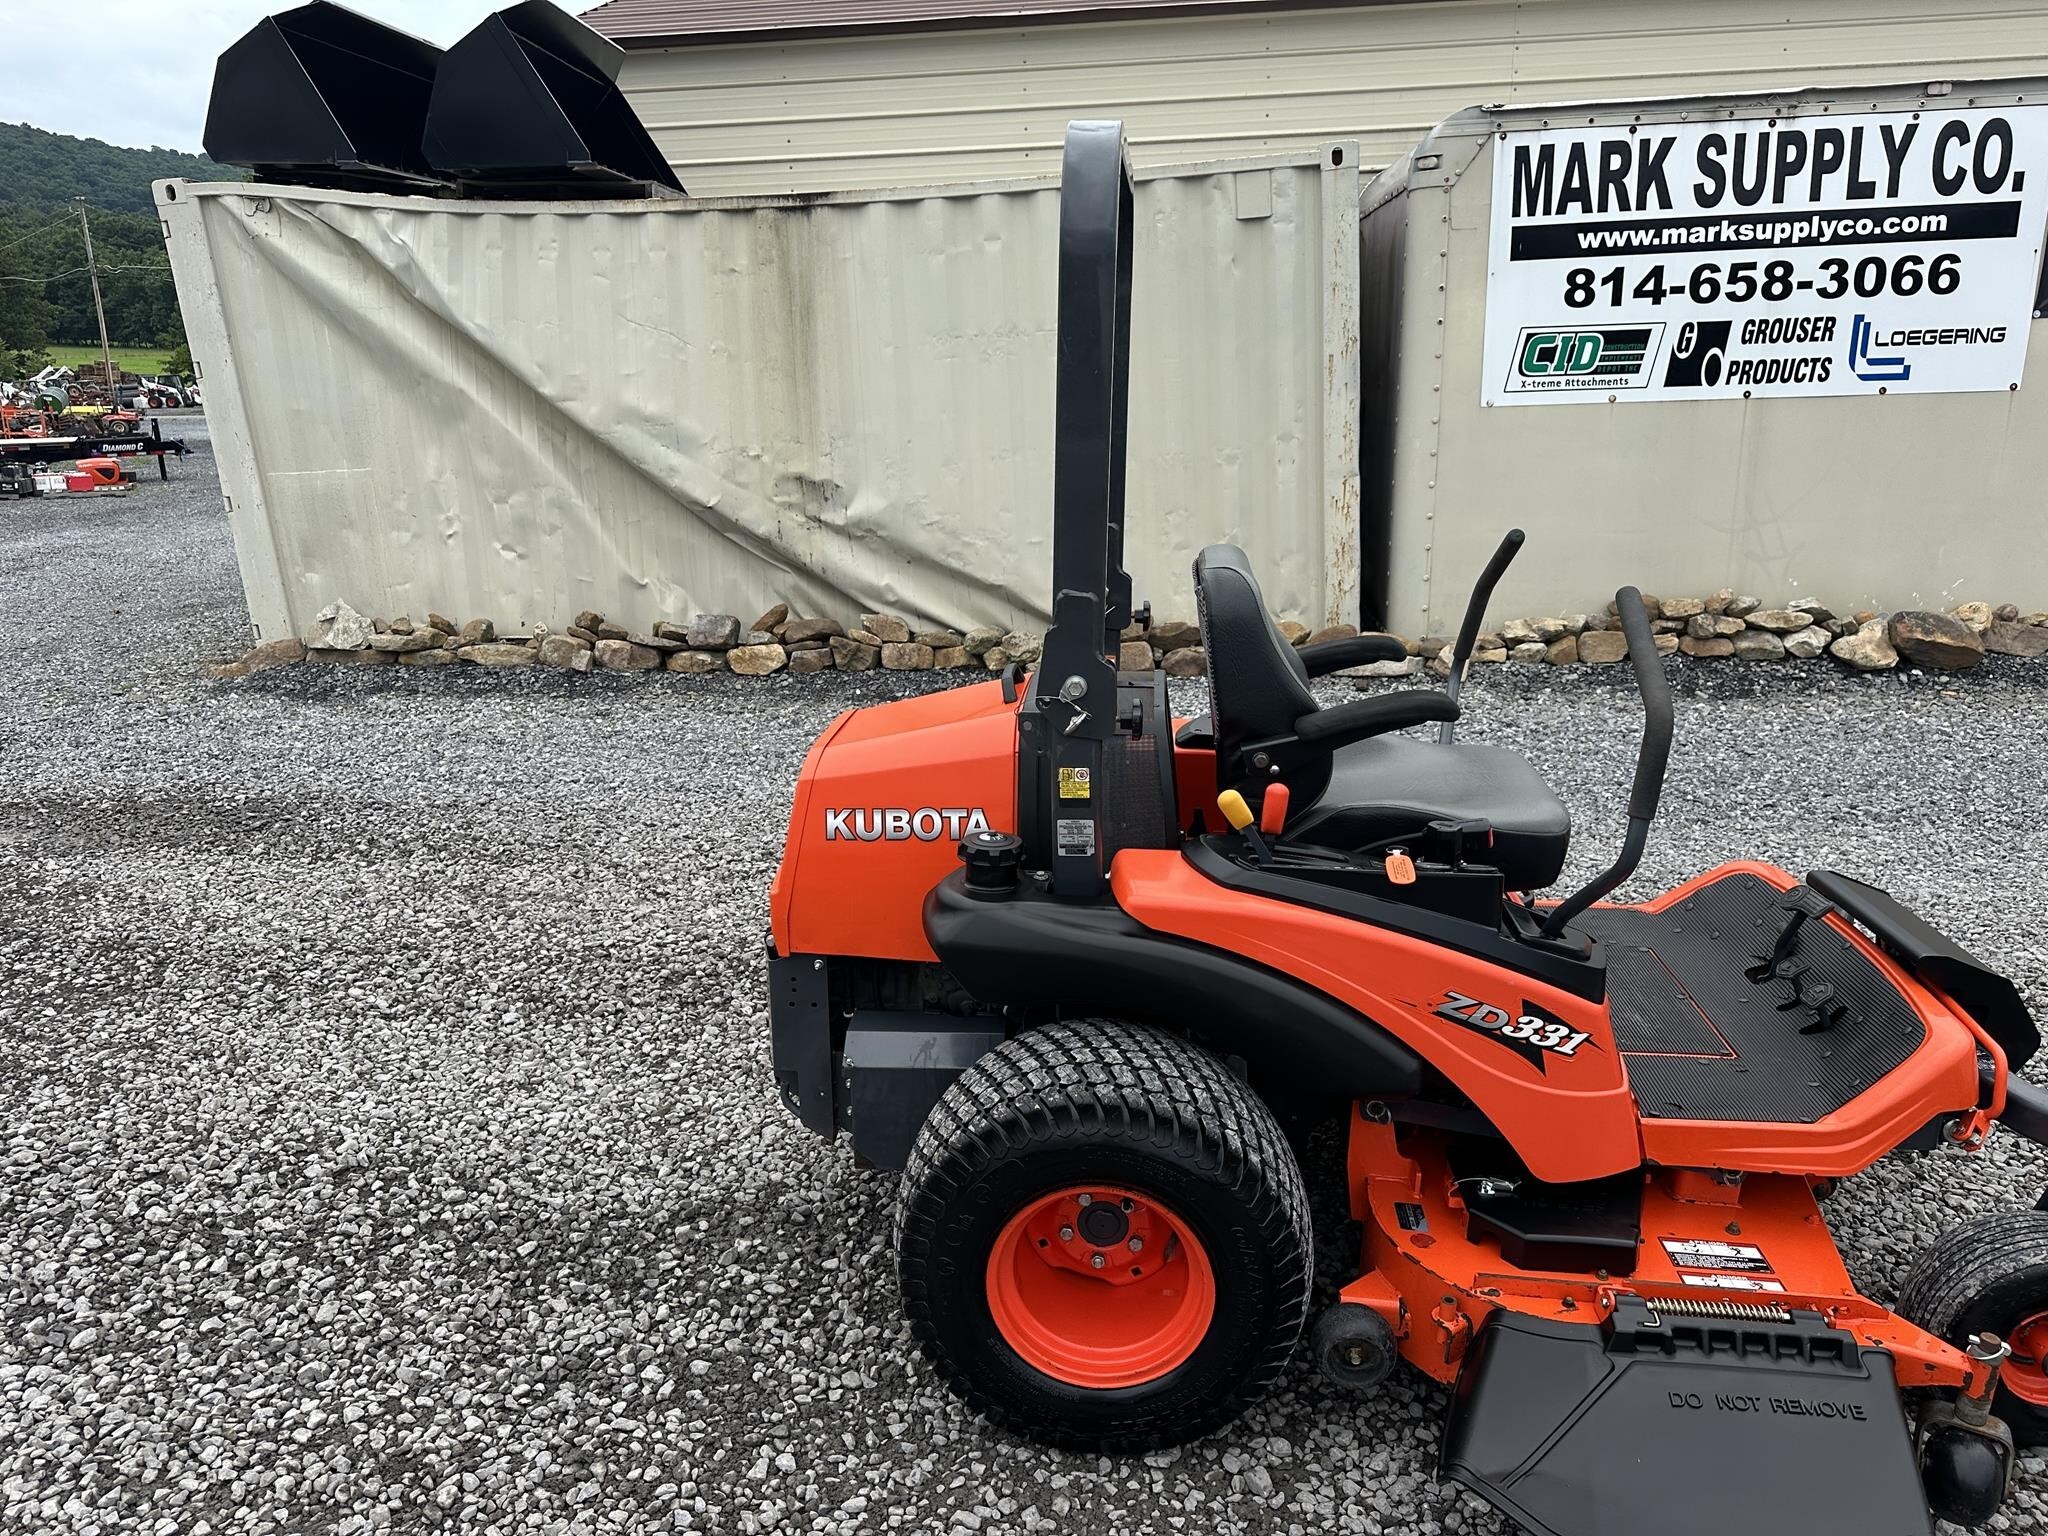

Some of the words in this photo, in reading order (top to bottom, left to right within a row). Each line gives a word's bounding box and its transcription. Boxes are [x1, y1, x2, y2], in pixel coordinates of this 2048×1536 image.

[1511, 136, 1677, 218] MARK
[1693, 123, 1919, 210] SUPPLY
[1932, 118, 2025, 196] CO.
[1577, 211, 1947, 250] www.marksupplyco.com
[1563, 253, 1961, 309] 814-658-3066
[1741, 316, 1837, 345] GROUSER
[1875, 326, 2007, 347] LOEGERING
[1523, 334, 1603, 375] CID
[1520, 379, 1562, 389] X-treme
[1565, 376, 1629, 387] Attachments
[1725, 357, 1832, 386] PRODUCTS
[102, 443, 136, 452] DIAMOND
[137, 442, 144, 450] C
[825, 807, 990, 841] KUBOTA
[1436, 991, 1590, 1055] ZD331
[1669, 1392, 1703, 1409] DO
[1715, 1394, 1760, 1412] NOT
[1769, 1397, 1867, 1421] REMOVE
